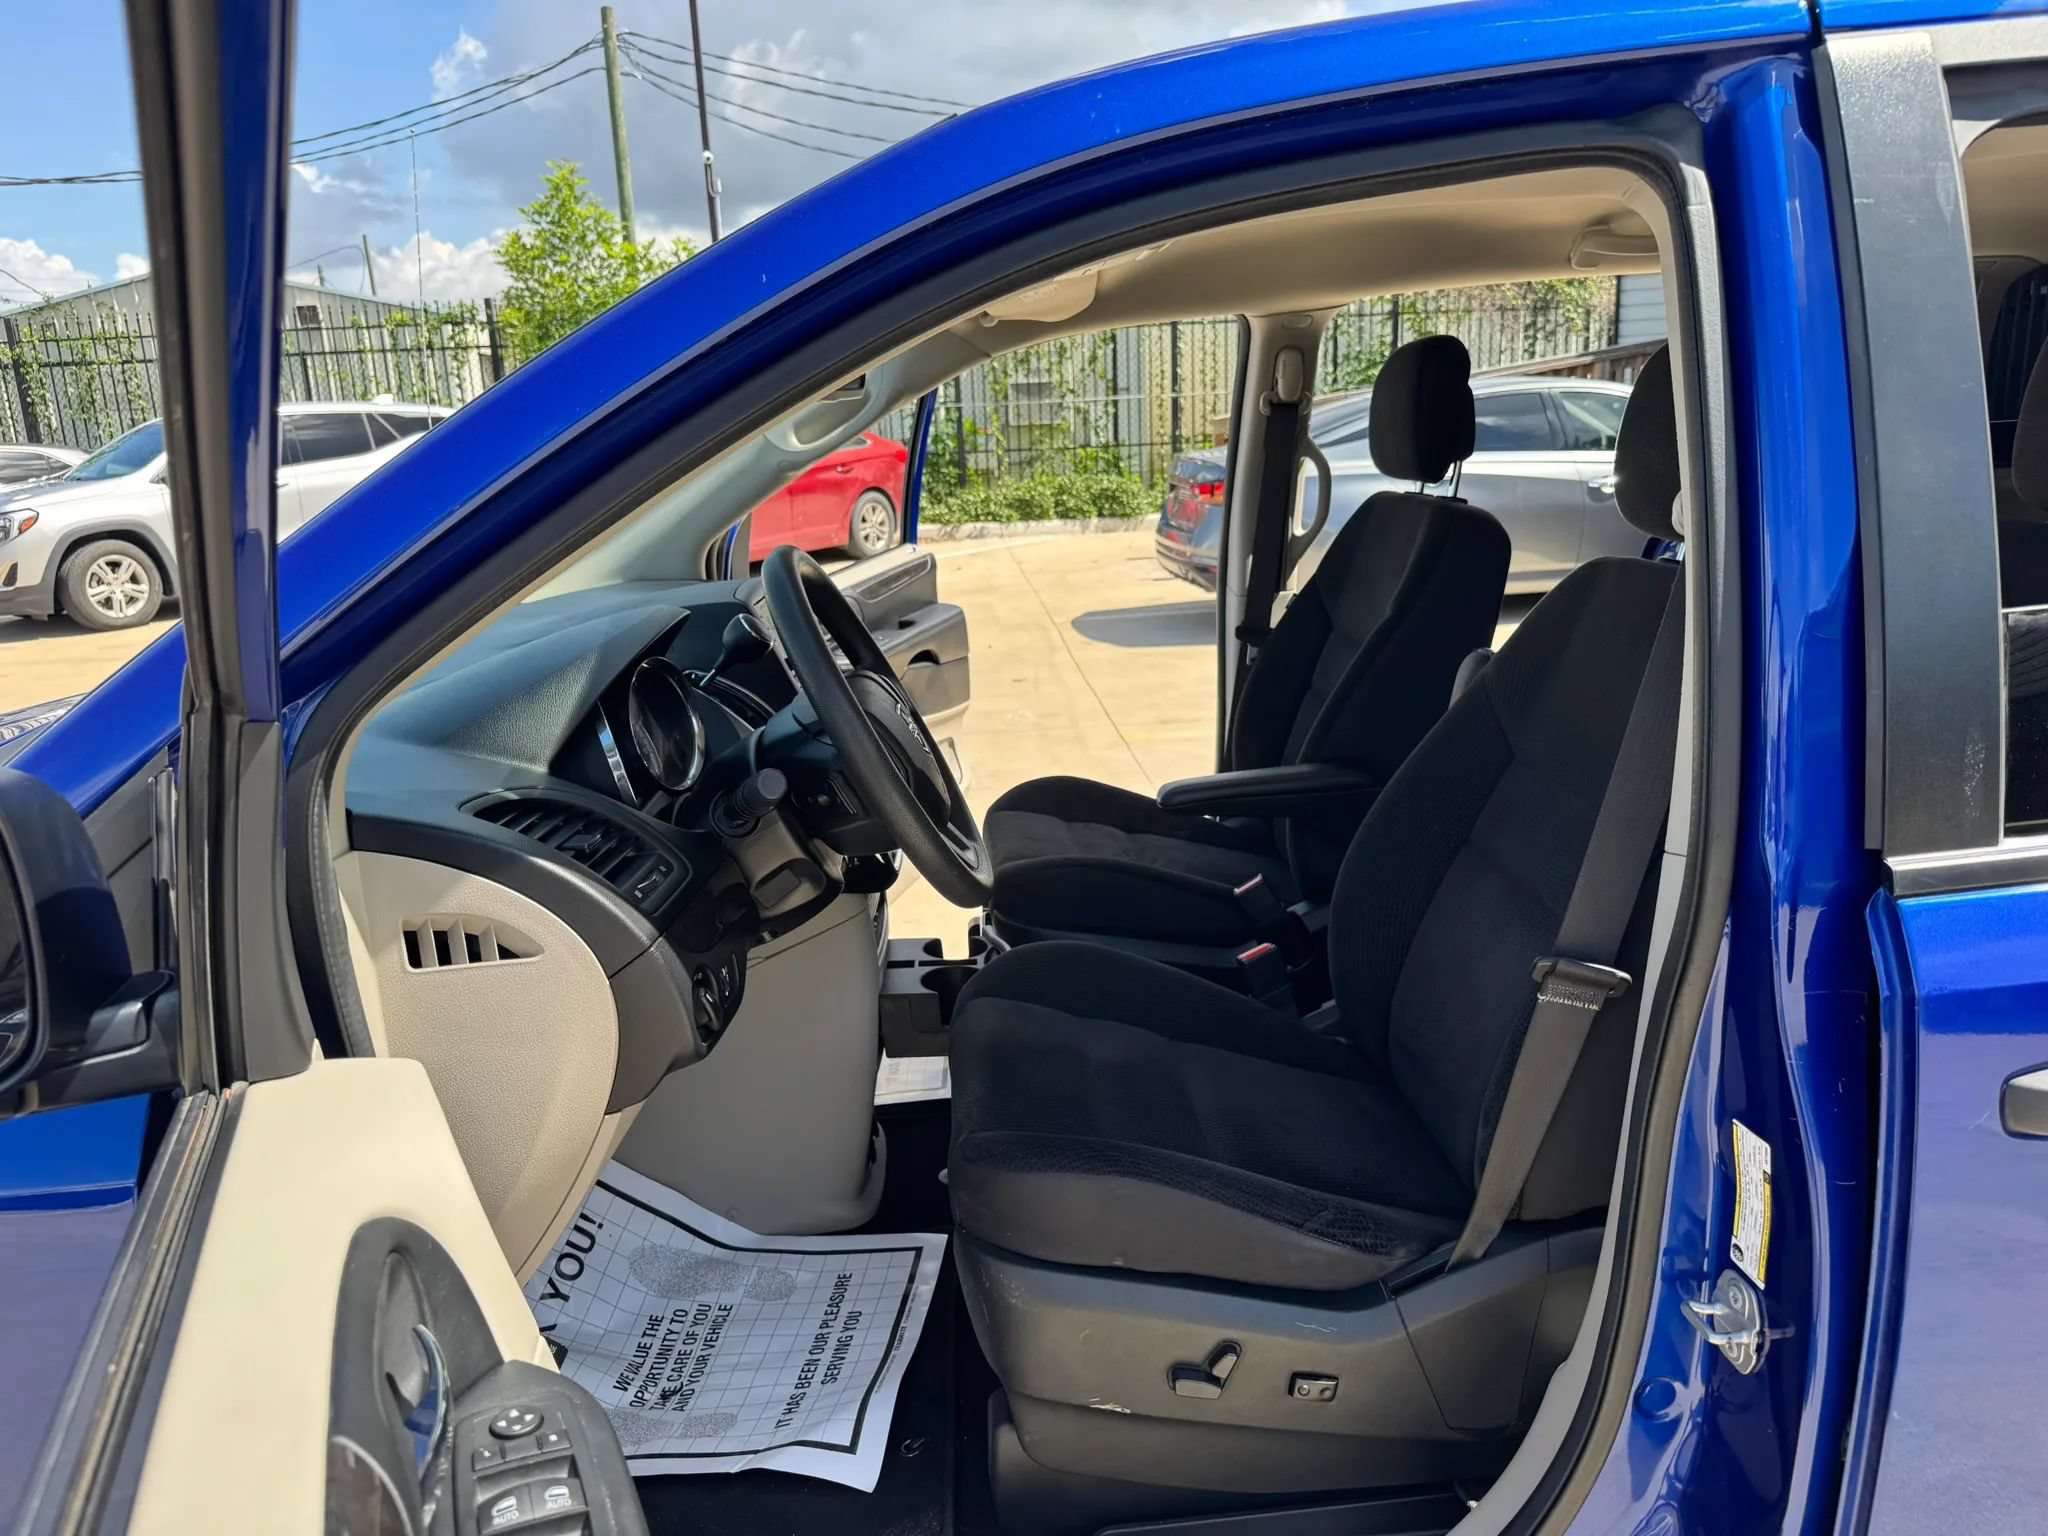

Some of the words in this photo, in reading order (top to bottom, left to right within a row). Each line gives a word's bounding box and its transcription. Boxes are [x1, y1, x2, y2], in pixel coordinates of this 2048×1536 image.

[538, 1212, 604, 1303] YOU!
[689, 1304, 712, 1328] YOU
[819, 1272, 853, 1330] PLEASURE
[613, 1372, 635, 1392] WE
[624, 1341, 653, 1375] VALUE
[641, 1314, 664, 1338] THE
[683, 1330, 699, 1345] OF
[809, 1331, 831, 1355] OUR
[821, 1334, 853, 1385] SERVING
[842, 1310, 862, 1332] YOU
[629, 1328, 680, 1407] OPPORTUNITY
[669, 1309, 688, 1325] TO
[667, 1349, 693, 1382] CARE
[671, 1388, 695, 1412] AND
[685, 1353, 712, 1386] YOUR
[701, 1304, 733, 1351] VEHICLE
[795, 1358, 821, 1390] BEEN
[782, 1392, 806, 1415] HAS
[774, 1417, 793, 1429] IT
[493, 1510, 519, 1525] AUTO
[546, 1498, 571, 1509] AUTO
